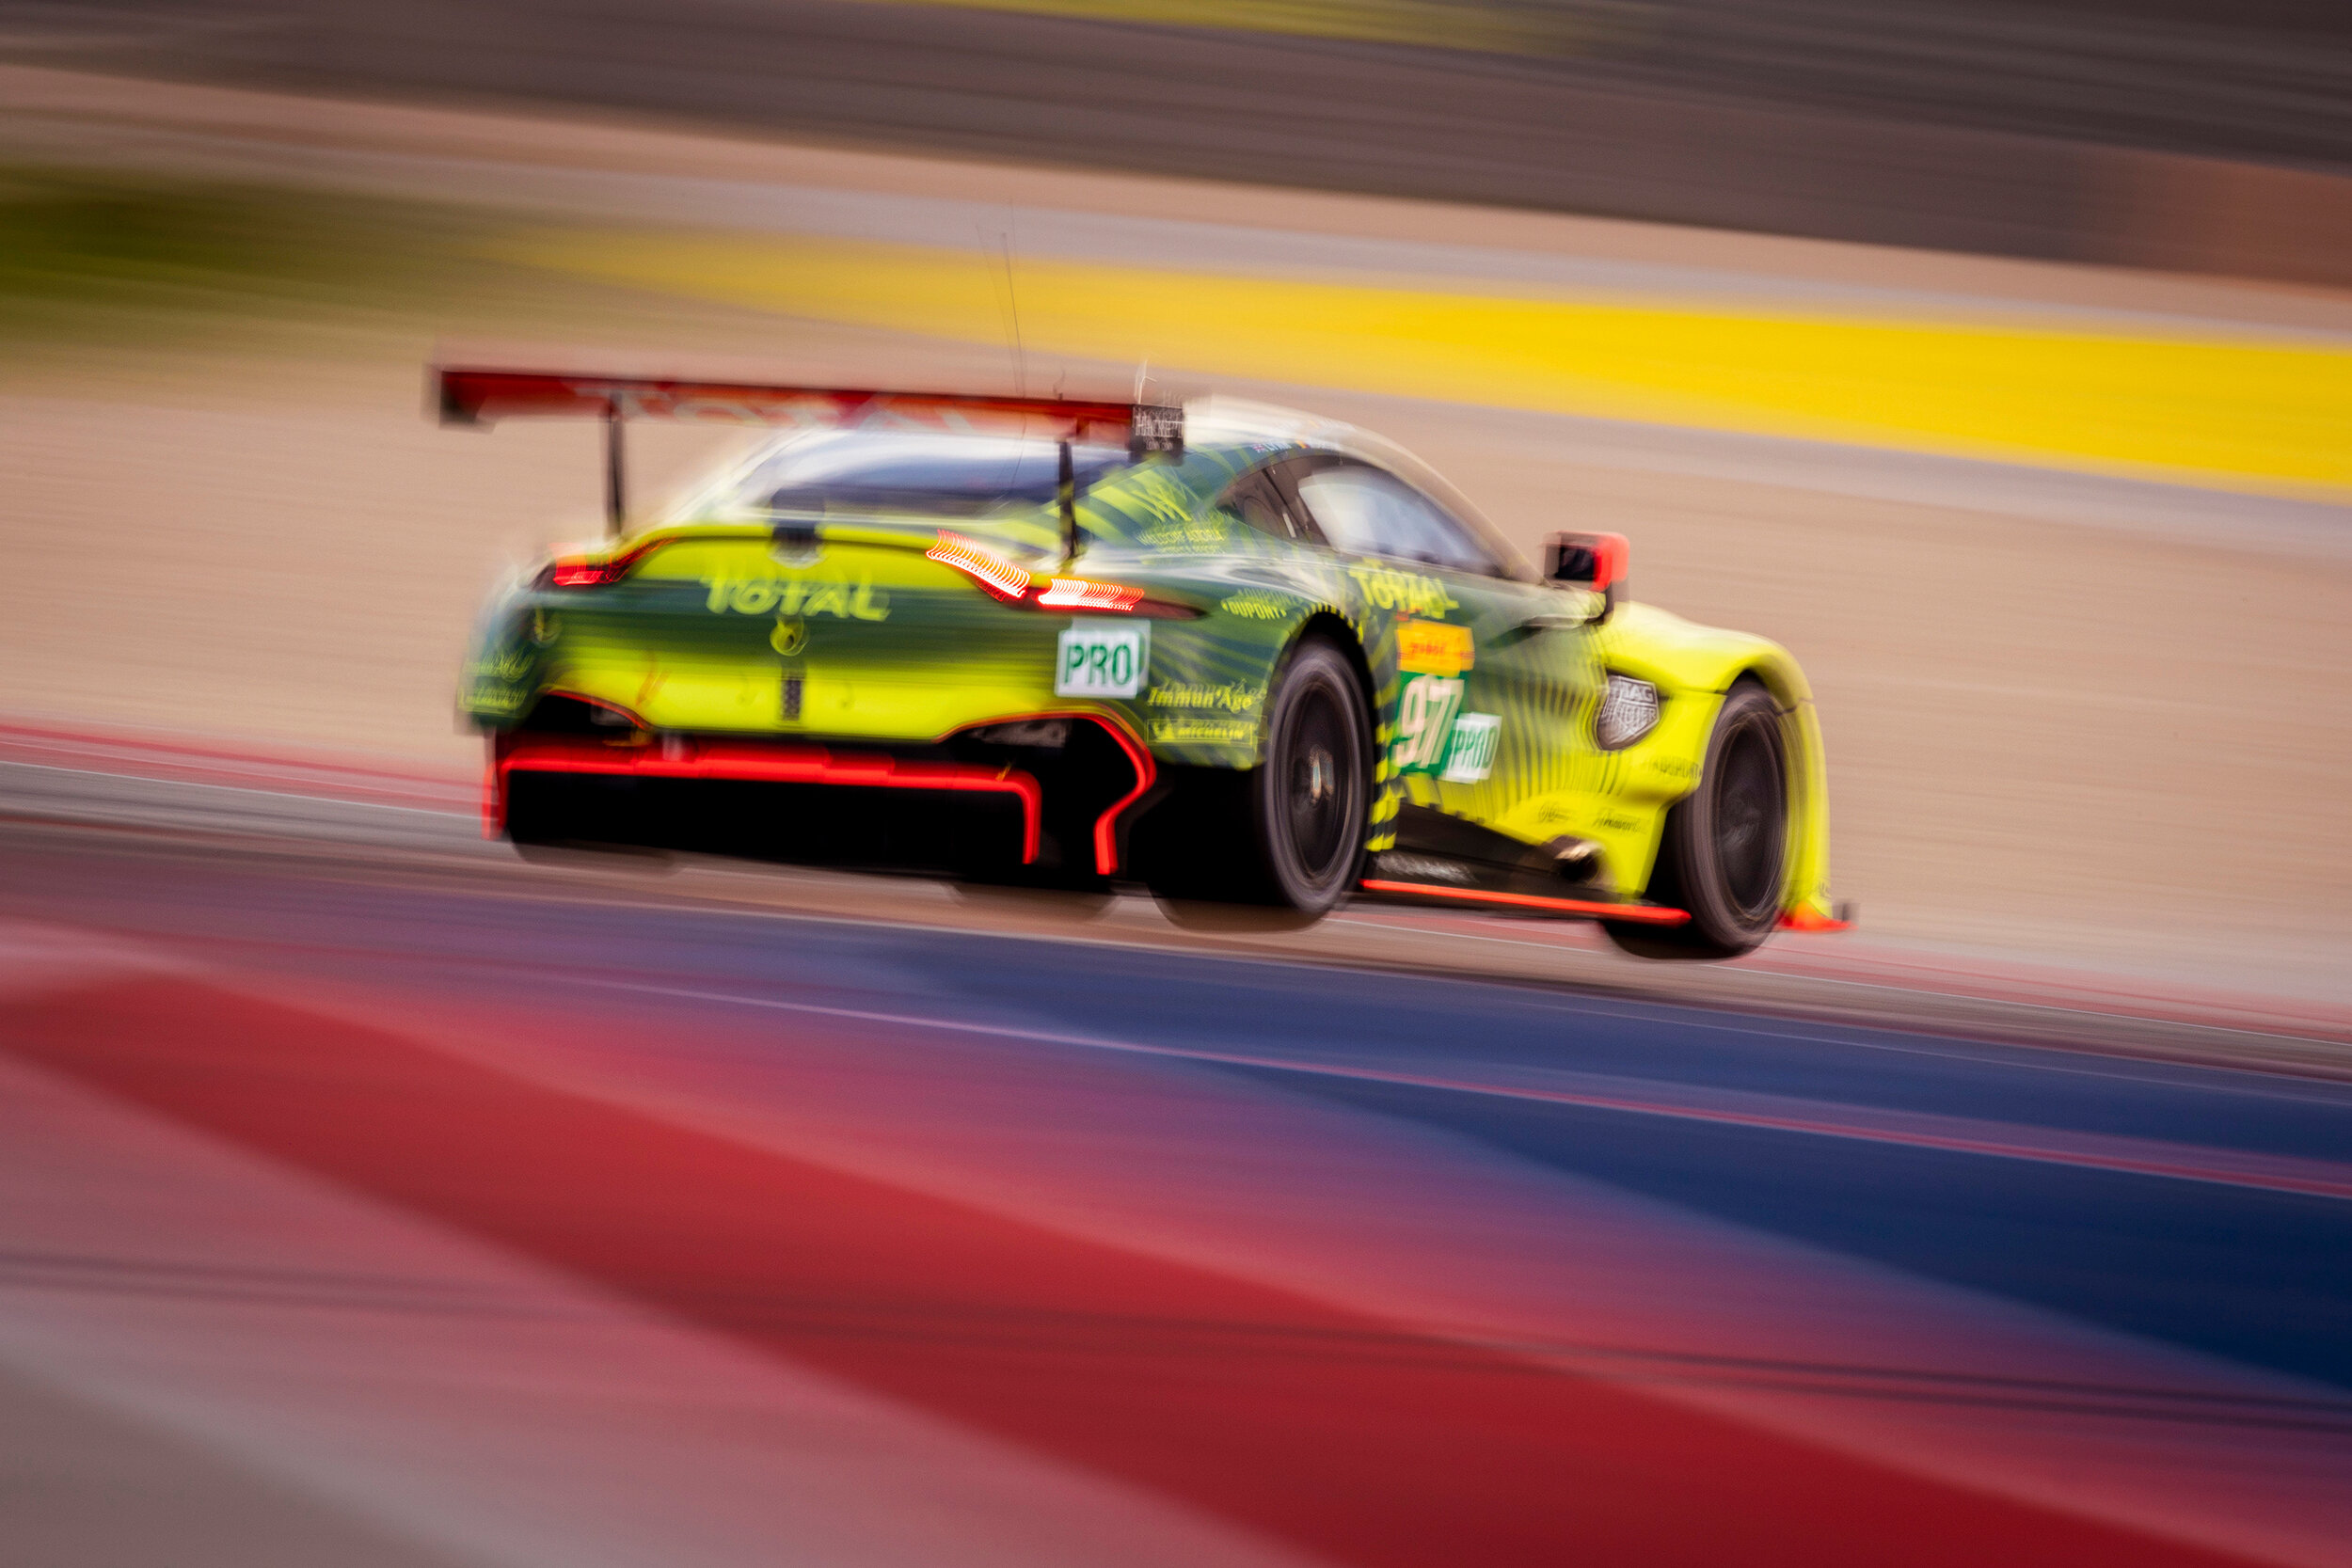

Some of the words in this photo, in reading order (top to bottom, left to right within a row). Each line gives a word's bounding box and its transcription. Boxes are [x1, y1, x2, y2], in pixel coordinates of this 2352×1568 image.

[699, 564, 892, 622] TOTAL
[1063, 643, 1135, 687] PRO
[1394, 676, 1464, 769] 97
